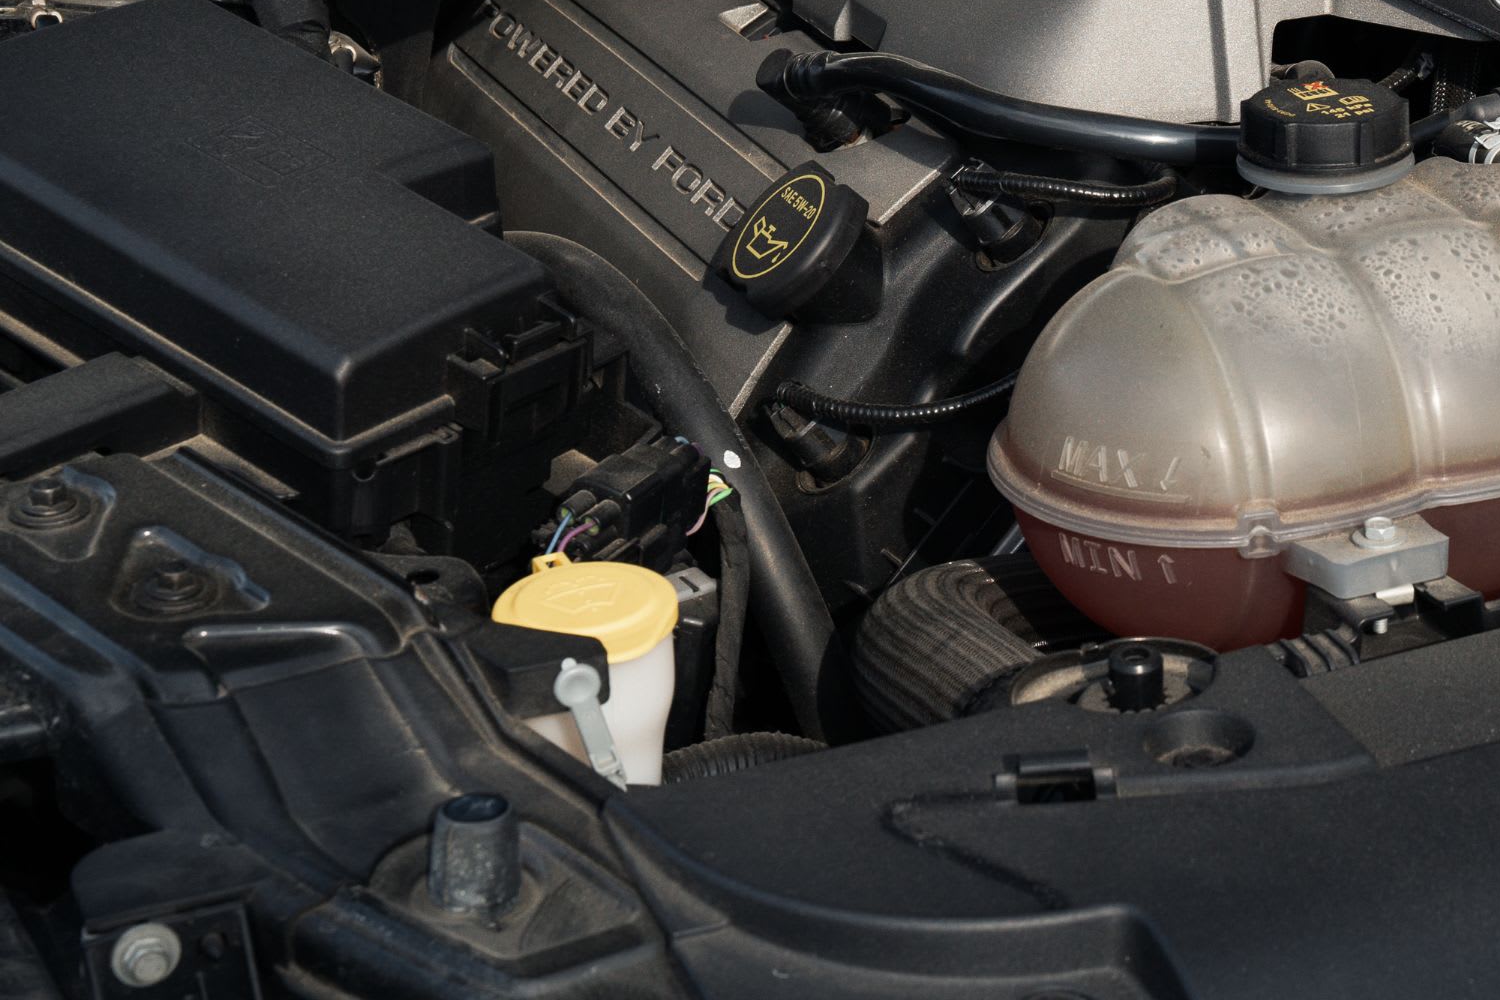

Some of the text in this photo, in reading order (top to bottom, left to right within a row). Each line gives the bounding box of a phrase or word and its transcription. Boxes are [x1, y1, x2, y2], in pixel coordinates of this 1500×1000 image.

[605, 106, 661, 153] BY
[652, 145, 748, 232] FORD
[781, 186, 817, 220] SAE 5W-20
[1058, 435, 1146, 488] MAX
[1058, 532, 1143, 581] MIN
